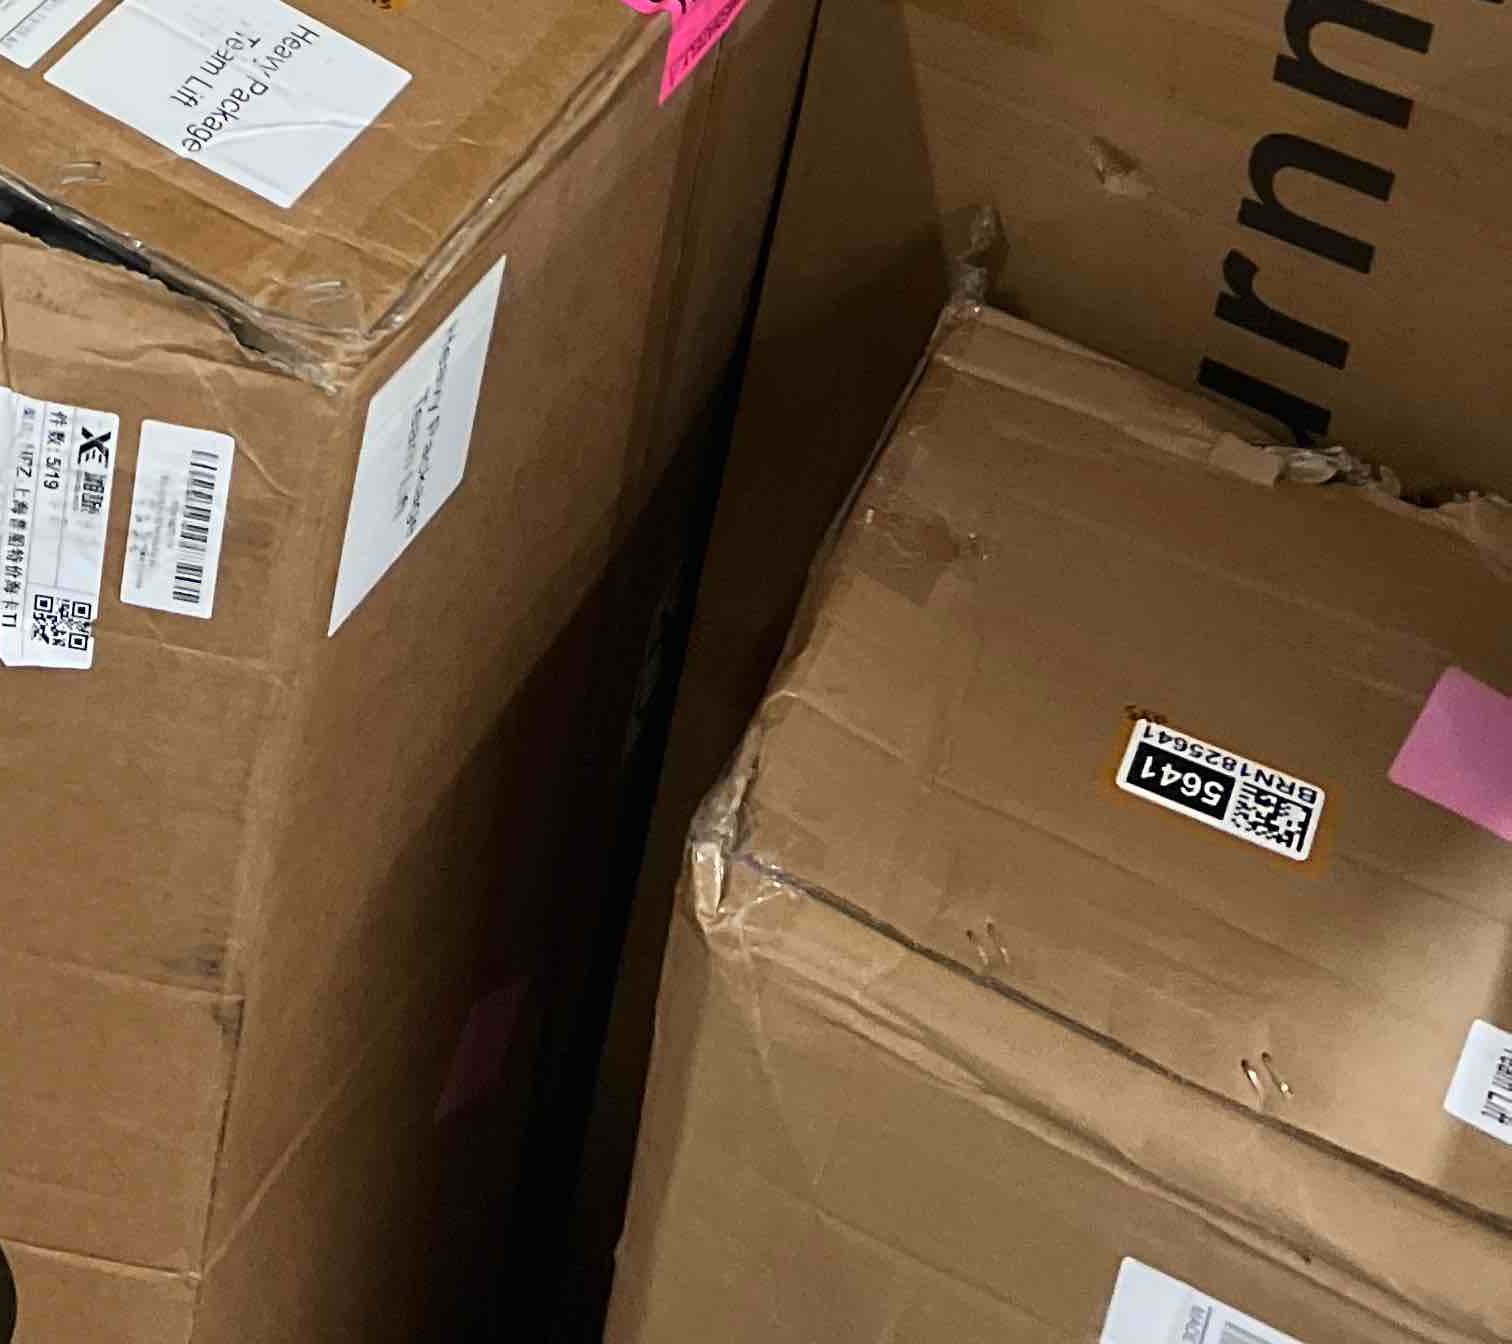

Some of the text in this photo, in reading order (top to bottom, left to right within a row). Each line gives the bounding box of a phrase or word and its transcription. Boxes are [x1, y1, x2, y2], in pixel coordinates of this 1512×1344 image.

[168, 32, 261, 110] Team Lift
[181, 23, 320, 154] Heavy Package
[42, 455, 62, 491] 5/19
[1139, 755, 1226, 810] 5641
[1142, 724, 1318, 806] BRN1825641
